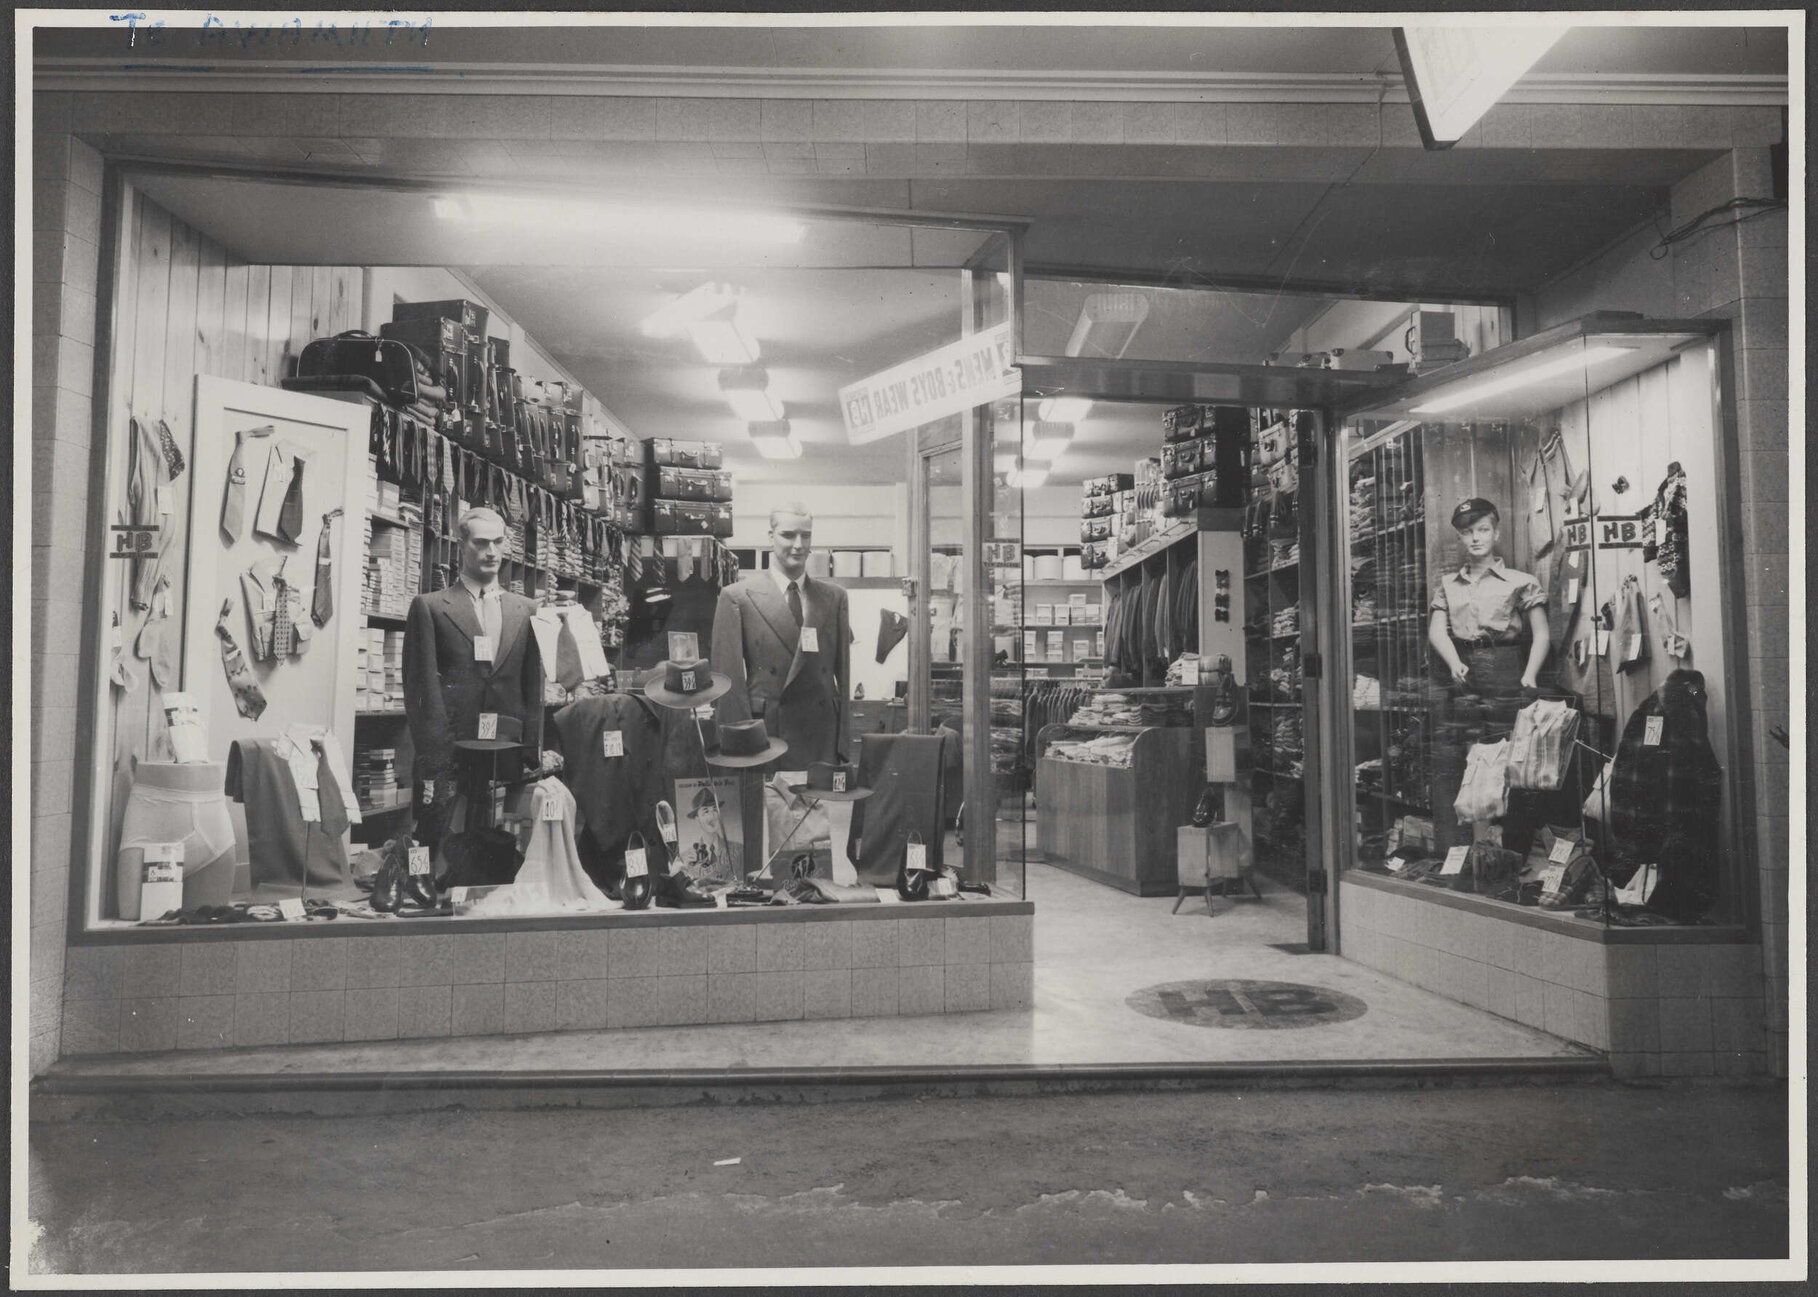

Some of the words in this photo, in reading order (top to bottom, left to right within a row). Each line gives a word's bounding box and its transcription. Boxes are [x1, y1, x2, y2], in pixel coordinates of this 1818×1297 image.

[117, 531, 152, 552] HB
[1567, 524, 1586, 545] HB
[1604, 522, 1636, 542] HB
[987, 544, 1015, 562] HB
[1158, 988, 1339, 1017] HB
